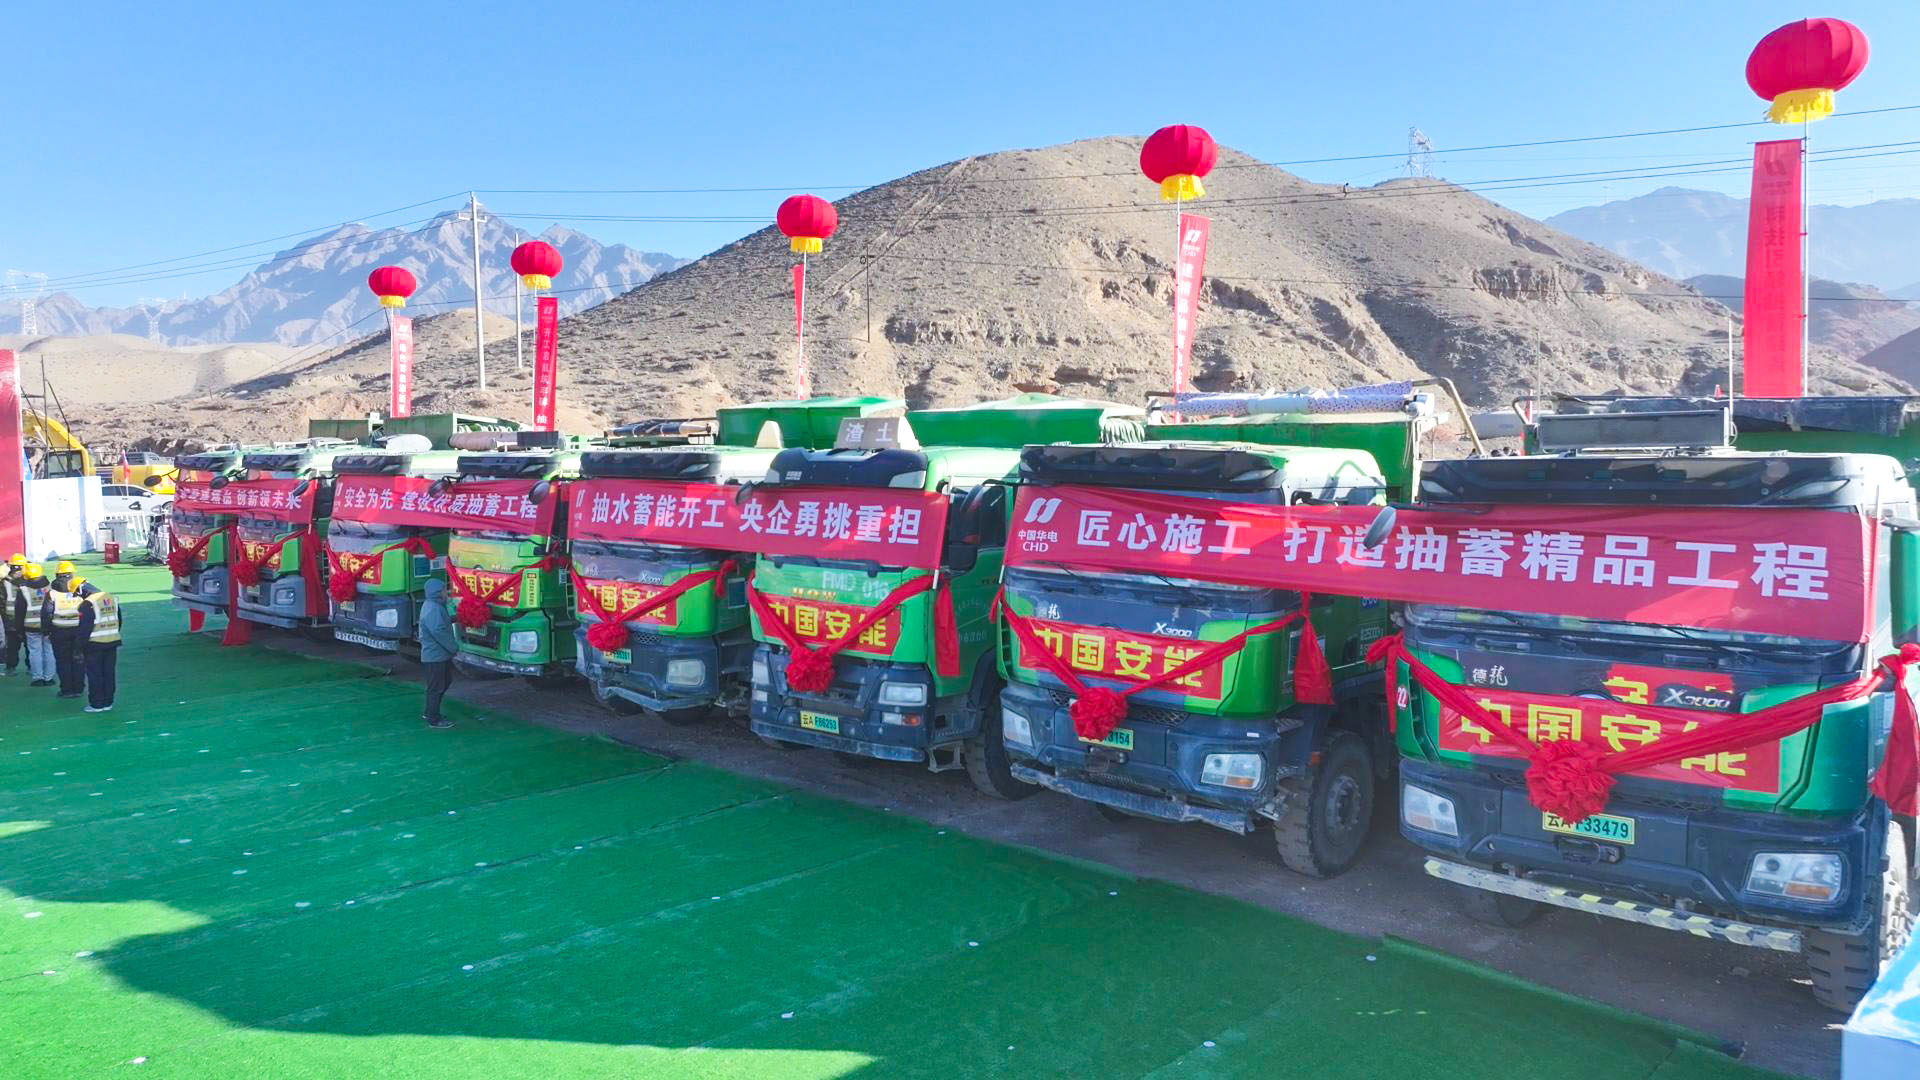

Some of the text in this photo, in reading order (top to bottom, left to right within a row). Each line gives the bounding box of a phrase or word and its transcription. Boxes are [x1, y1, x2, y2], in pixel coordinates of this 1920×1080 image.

[344, 487, 393, 511] 安全为先
[591, 491, 726, 529] 抽水蓄能开工
[738, 497, 922, 545] 央企勇挑重担
[1018, 528, 1058, 543] 中国华电
[1022, 541, 1049, 553] CHD
[1077, 508, 1830, 601] 匠心施工 打造抽蓄精品工程
[1152, 622, 1193, 637] X3000
[1663, 688, 1731, 708] X3000
